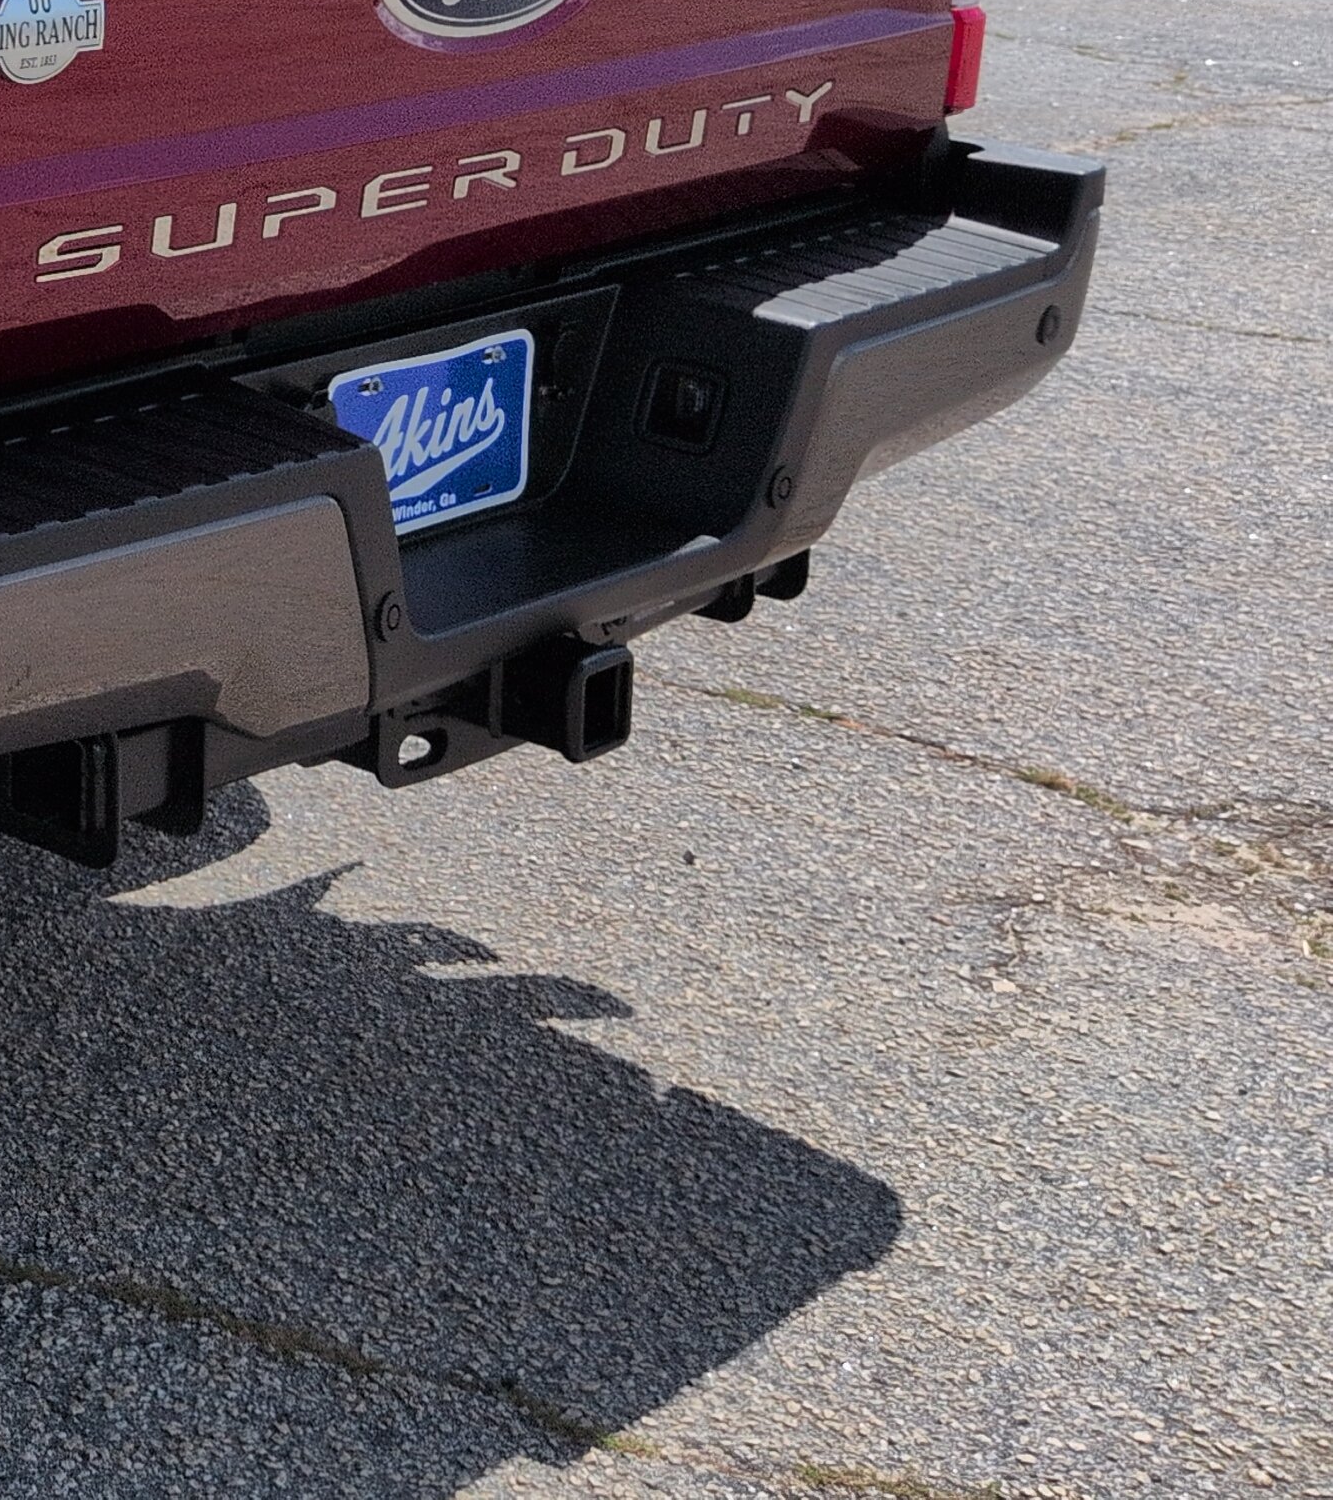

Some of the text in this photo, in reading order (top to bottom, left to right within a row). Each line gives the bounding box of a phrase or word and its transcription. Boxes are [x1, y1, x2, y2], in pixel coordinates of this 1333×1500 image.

[35, 9, 98, 47] RANCH
[33, 81, 835, 283] SUPER DUTY
[373, 377, 505, 484] Akins
